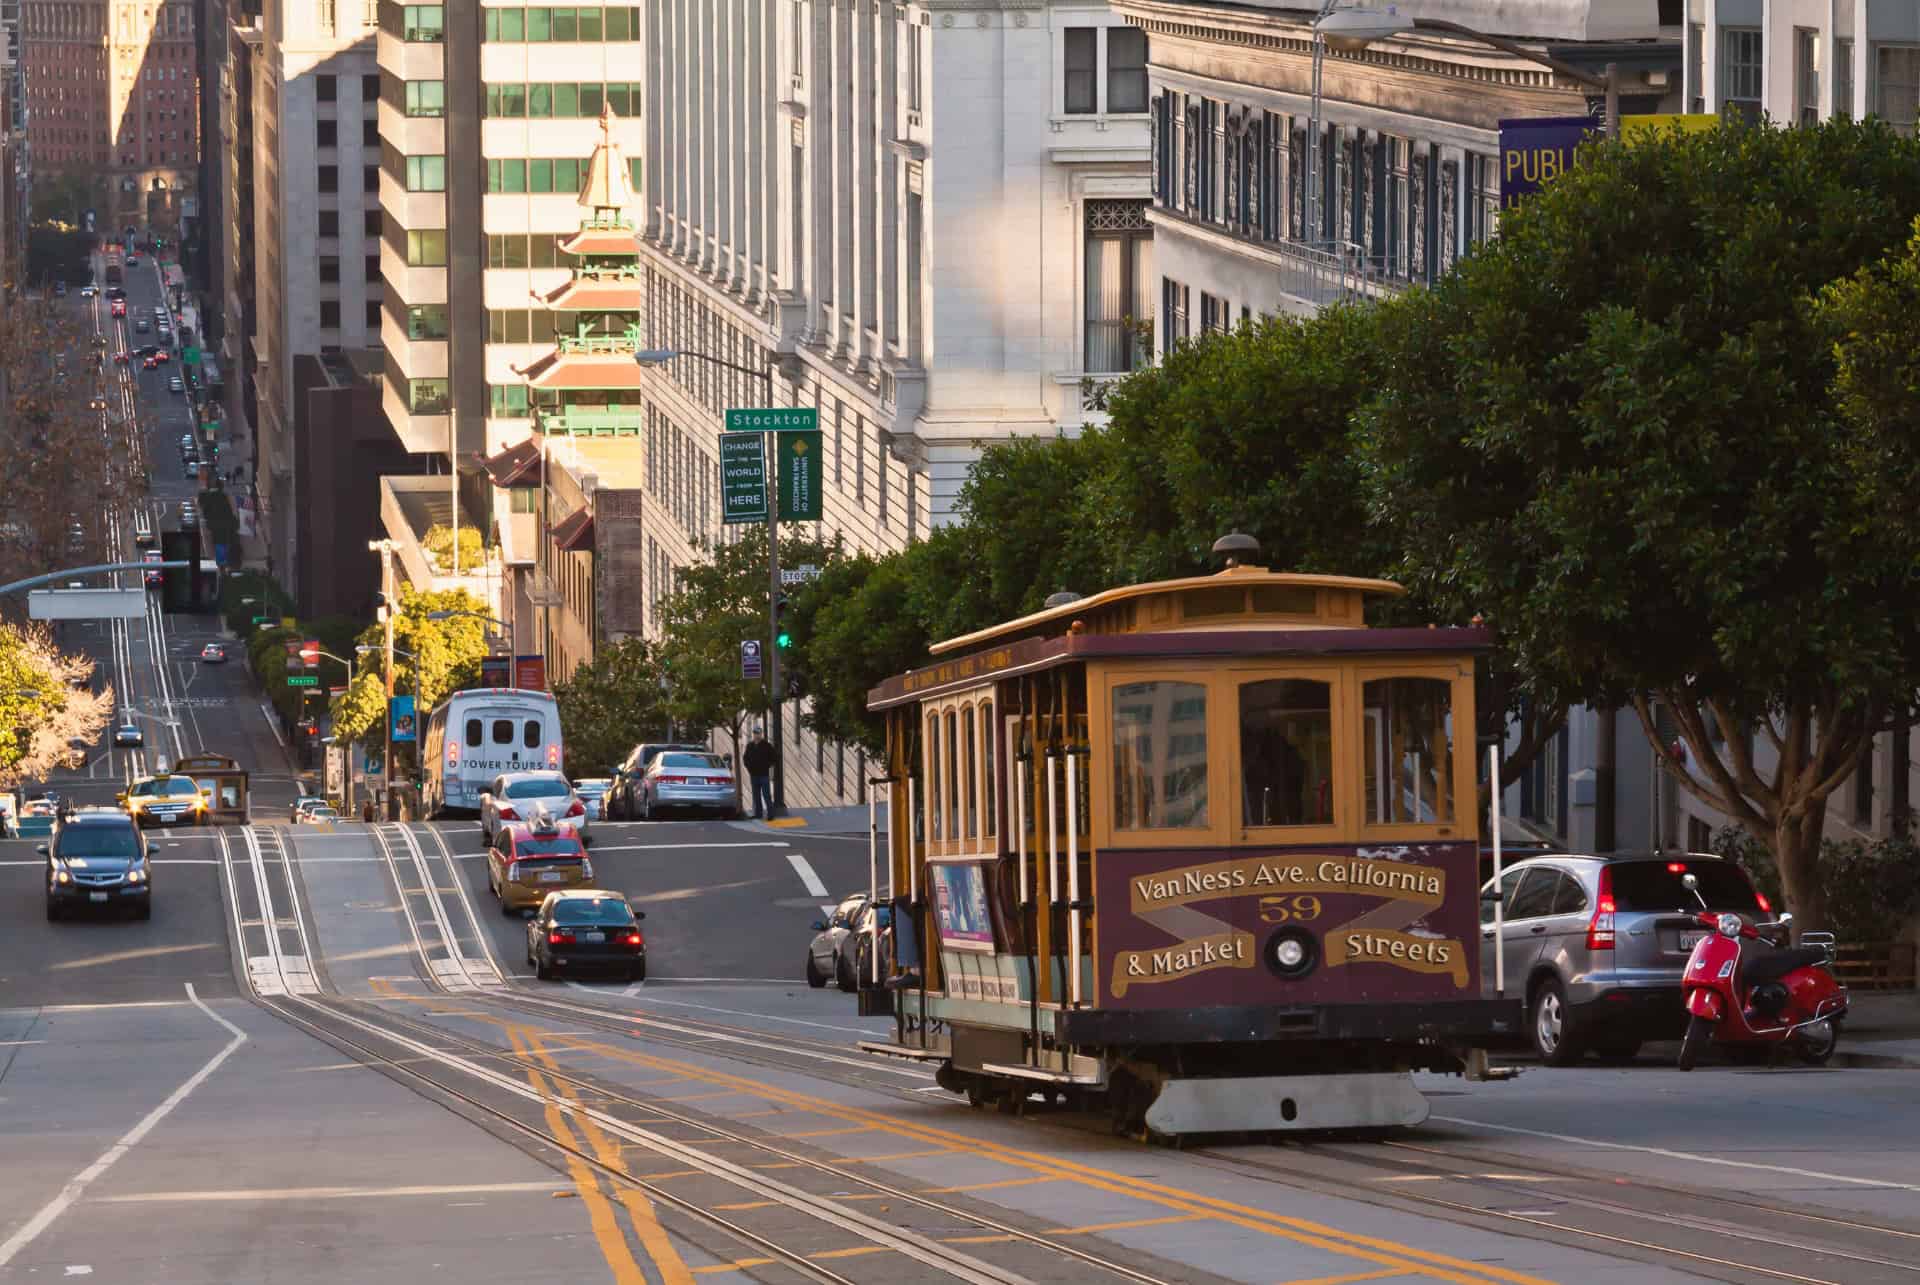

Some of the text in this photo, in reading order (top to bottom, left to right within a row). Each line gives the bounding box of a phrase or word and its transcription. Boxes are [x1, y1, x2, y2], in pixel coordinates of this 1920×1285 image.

[1505, 148, 1577, 183] PUBLI
[733, 414, 811, 425] Stockton
[724, 442, 760, 451] CHANGE
[726, 468, 760, 477] WORLD
[729, 495, 761, 505] HERE
[463, 760, 543, 770] TOWER TOURS
[1137, 879, 1181, 900] Van
[1184, 869, 1245, 894] Ness
[1318, 861, 1440, 894] California
[1259, 895, 1322, 923] 59
[1128, 938, 1244, 976] & Market
[1347, 934, 1449, 963] Streets
